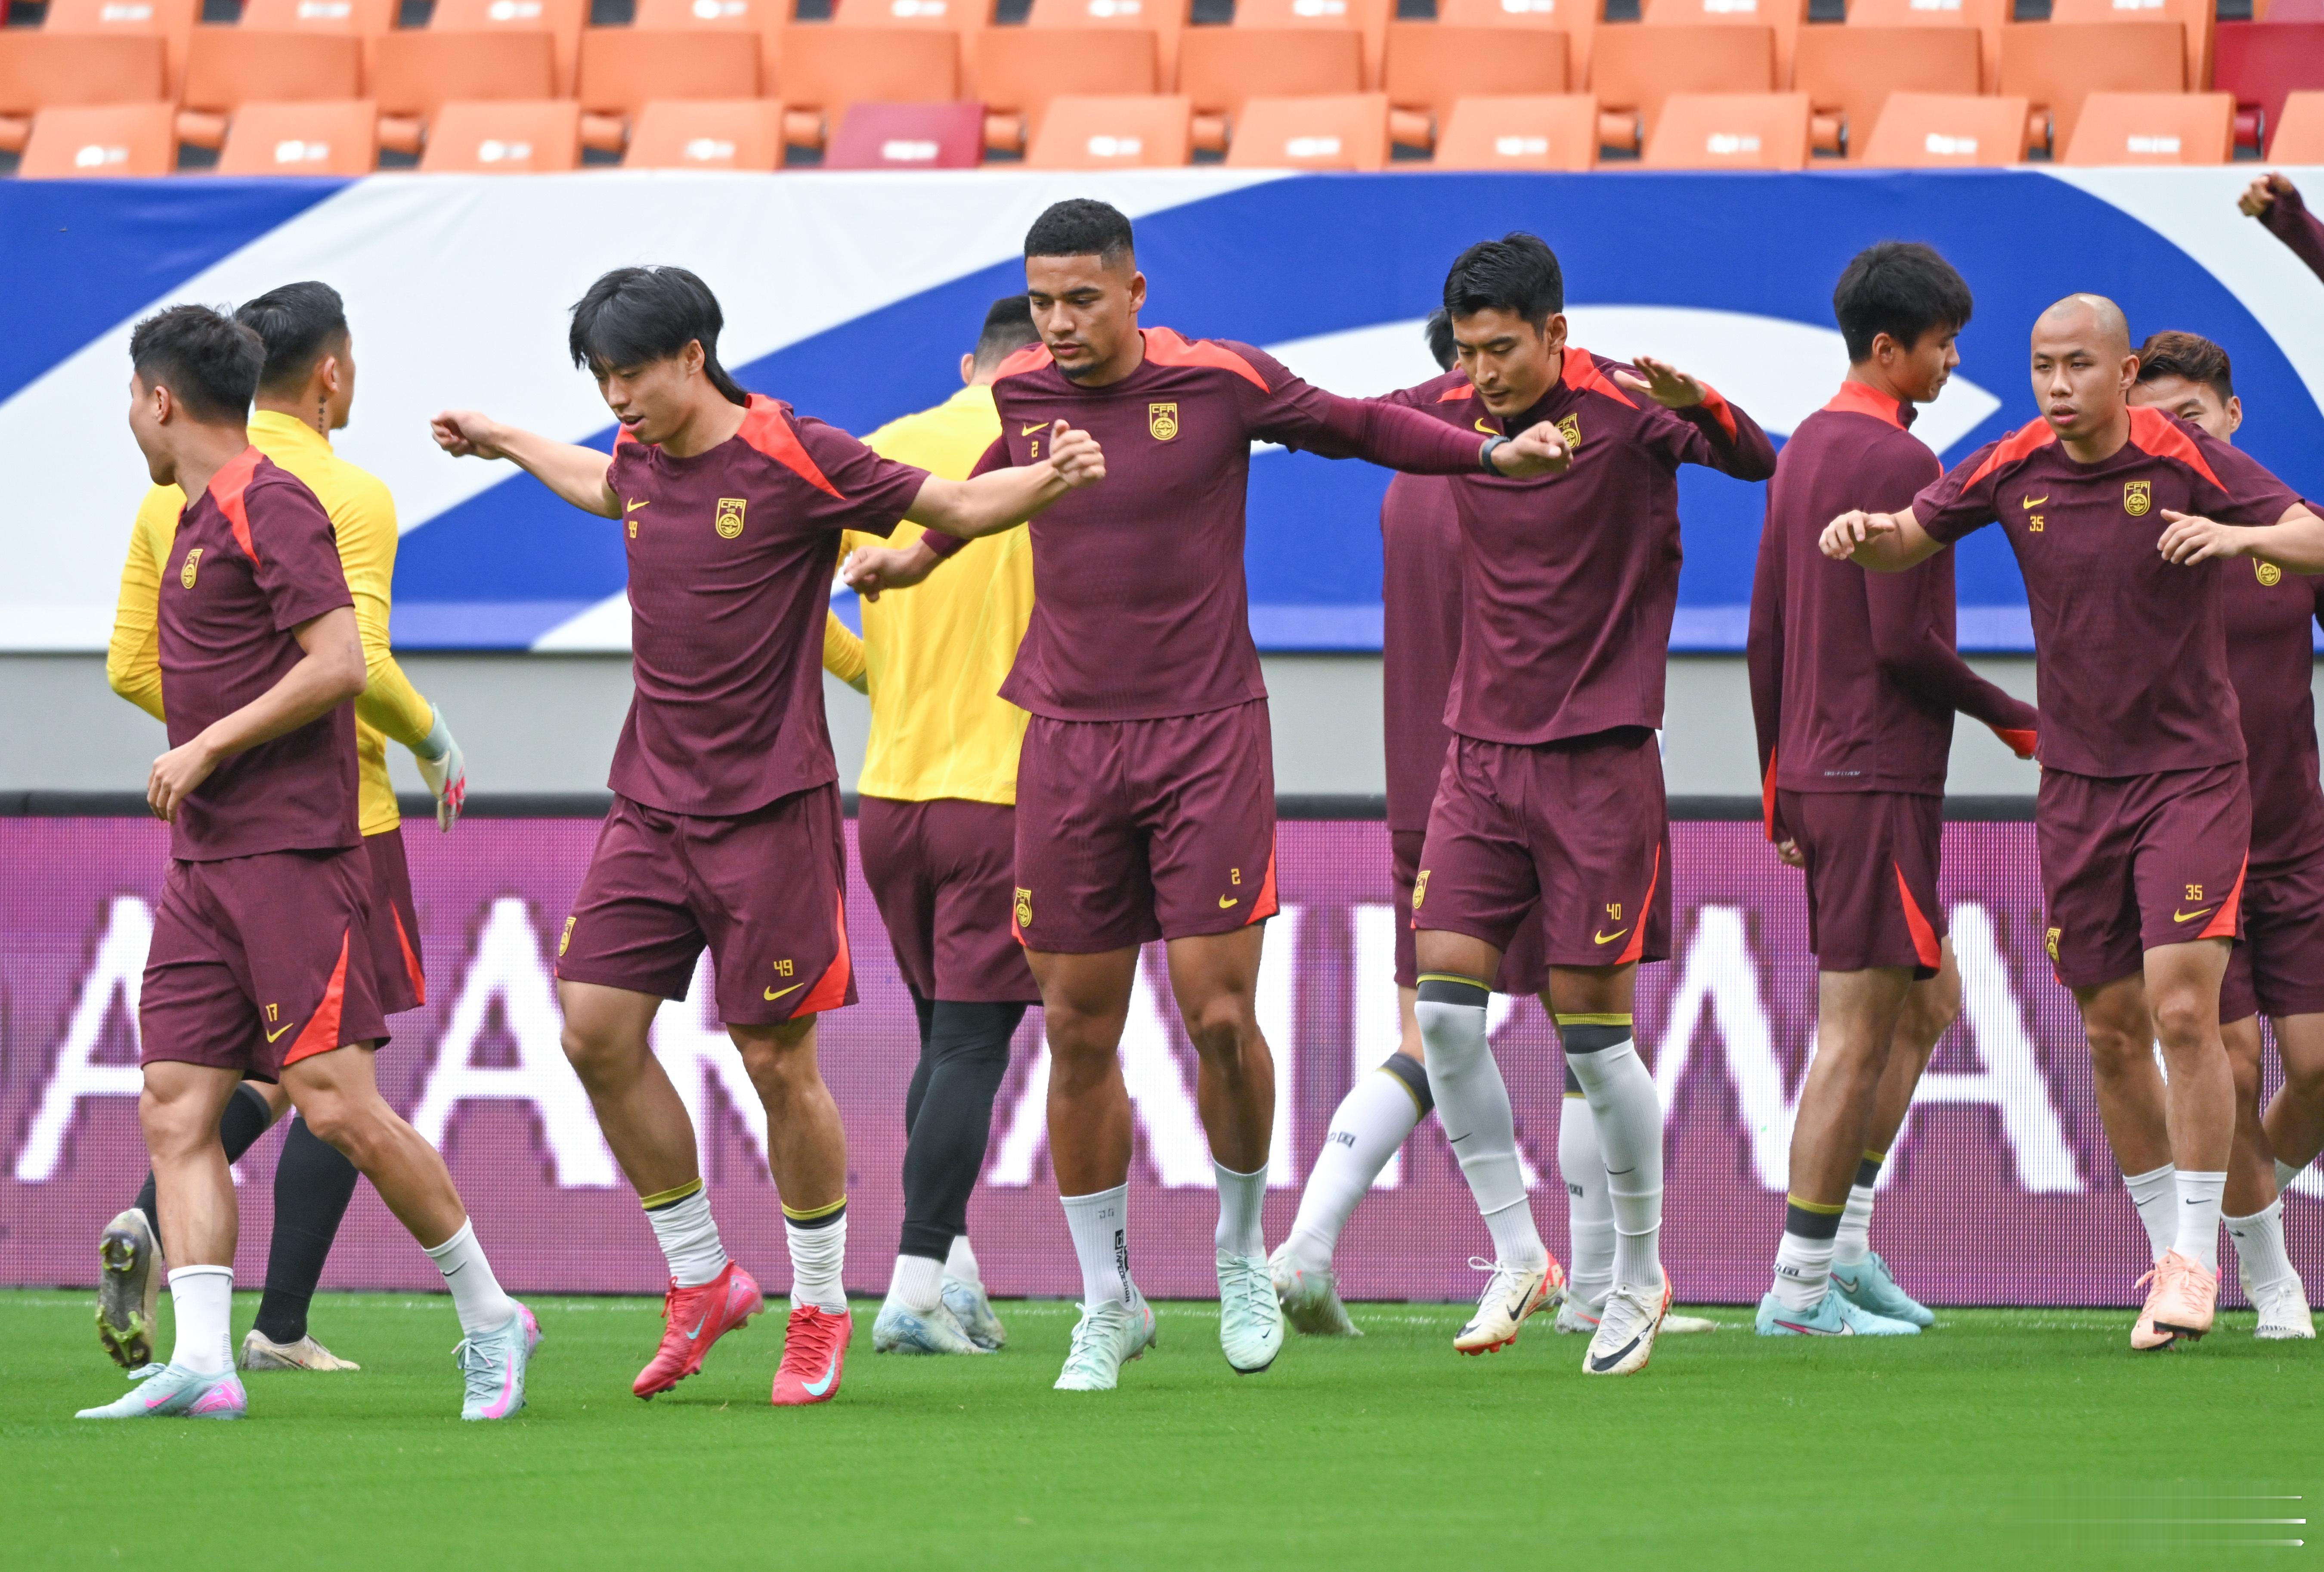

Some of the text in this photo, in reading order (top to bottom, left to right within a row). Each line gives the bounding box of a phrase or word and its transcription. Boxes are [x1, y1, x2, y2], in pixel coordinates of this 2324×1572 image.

[1557, 415, 1575, 429] CFA
[1031, 440, 1039, 458] 2
[721, 501, 743, 509] CFA
[2030, 516, 2044, 532] 35
[1231, 868, 1241, 885] 2
[2185, 884, 2203, 900] 35
[1606, 903, 1621, 920] 40
[774, 959, 794, 977] 49
[265, 1003, 278, 1022] 17
